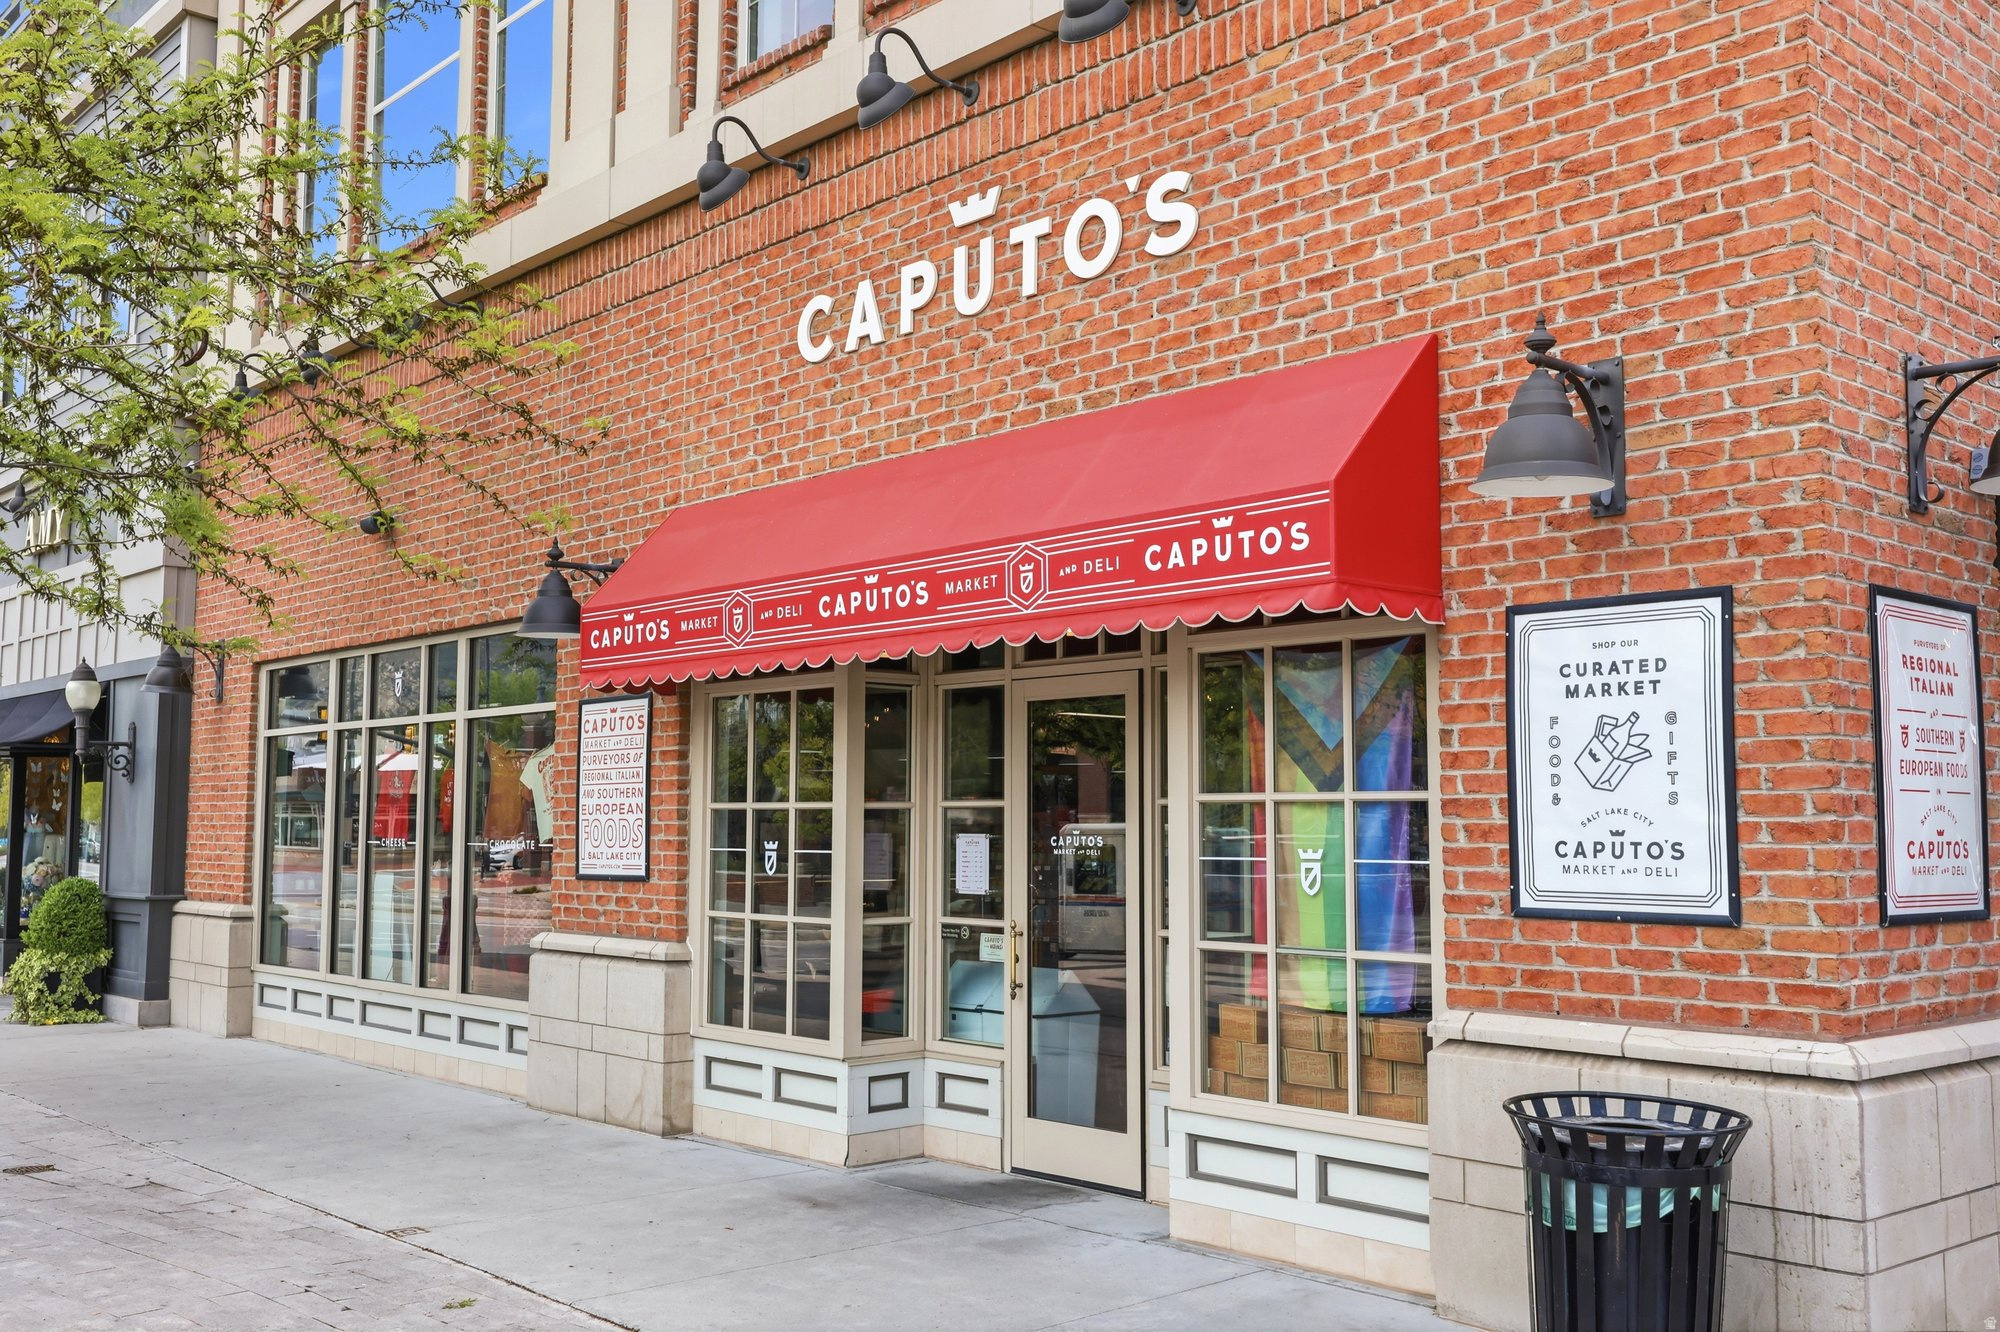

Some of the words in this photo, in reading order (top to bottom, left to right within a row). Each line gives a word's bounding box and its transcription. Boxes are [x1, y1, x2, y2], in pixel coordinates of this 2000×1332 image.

[796, 170, 1200, 364] CAPUTO'S
[590, 618, 670, 649] CAPUTO'S
[680, 615, 718, 632] MARKET
[760, 609, 773, 620] AND
[776, 603, 803, 619] DELI
[818, 580, 929, 618] CAPUTO'S
[945, 574, 998, 595] MARKET
[1059, 564, 1077, 577] AND
[1083, 555, 1120, 575] DELI
[1144, 521, 1310, 572] CAPUTO'S
[1592, 640, 1616, 650] SHOP
[1620, 638, 1639, 648] OUR
[1559, 657, 1668, 678] CURATED
[1901, 654, 1959, 677] REGIONAL
[1565, 679, 1661, 699] MARKET
[1910, 676, 1954, 697] ITALIAN
[583, 713, 645, 734] CAPUTO'S
[584, 739, 611, 750] MARKET
[624, 737, 642, 747] DELI
[1915, 727, 1955, 746] SOUTHERN
[582, 752, 631, 766] PURVEYORS
[633, 752, 644, 763] OF
[584, 771, 613, 782] REGIONAL
[615, 770, 641, 780] ITALIAN
[1900, 759, 1944, 777] EUROPEAN
[1946, 762, 1968, 779] FOODS
[581, 789, 595, 799] AND
[597, 787, 644, 799] SOUTHERN
[581, 803, 644, 816] EUROPEAN
[1580, 810, 1601, 828] SALT
[1605, 807, 1629, 816] LAKE
[1633, 811, 1654, 828] CITY
[1920, 808, 1932, 826] SALT
[1933, 804, 1946, 813] LAKE
[1947, 809, 1958, 825] CITY
[381, 837, 406, 848] CHEESE
[489, 839, 535, 850] CHOCOLATE
[581, 817, 644, 860] FOODS
[1050, 835, 1104, 847] CAPUTO'S
[588, 851, 604, 860] SALT
[605, 852, 624, 860] LAKE
[625, 852, 642, 861] CITY
[1554, 839, 1685, 861] CAPUTO'S
[1906, 838, 1969, 860] CAPUTO'S
[1562, 864, 1616, 876] MARKET
[1621, 867, 1638, 875] AND
[1645, 865, 1678, 878] DELI
[1912, 865, 1939, 876] MARKET
[1951, 865, 1967, 876] DELI
